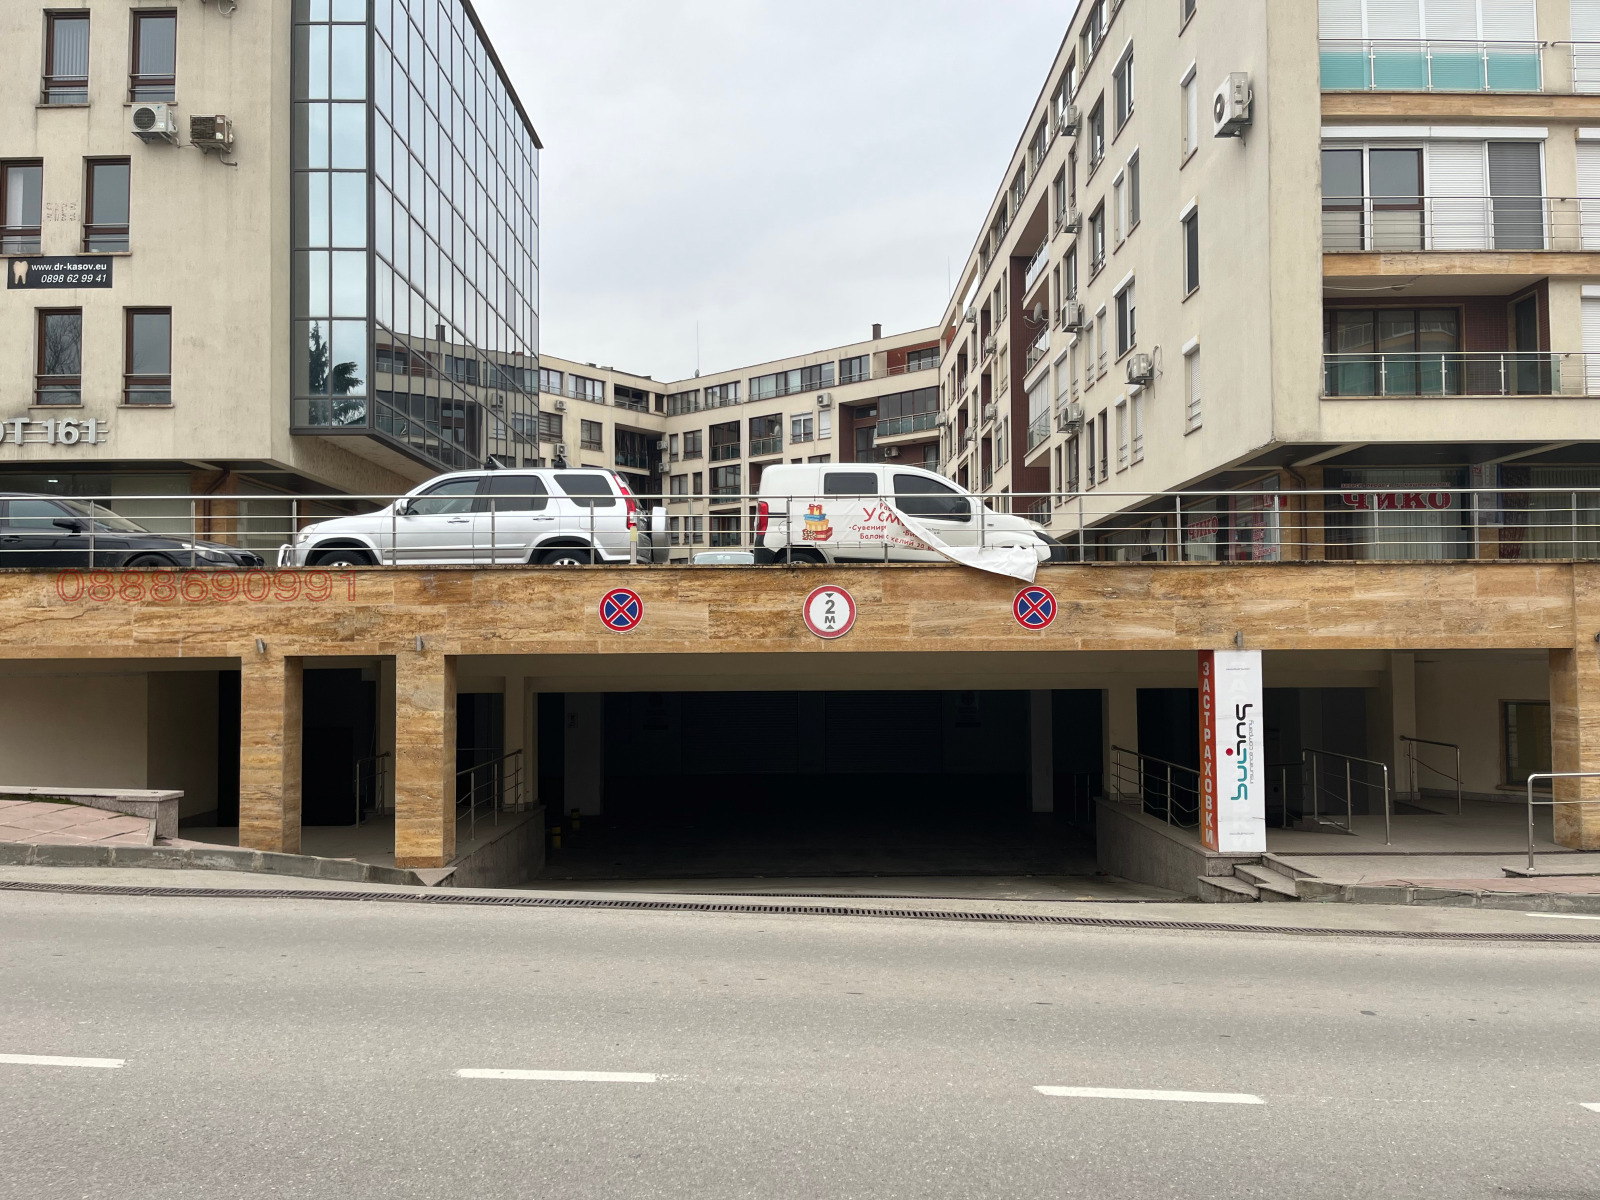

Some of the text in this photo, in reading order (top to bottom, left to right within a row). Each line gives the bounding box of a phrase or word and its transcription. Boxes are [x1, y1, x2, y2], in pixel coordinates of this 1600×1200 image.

[31, 262, 107, 271] www.dr-kasov.eu
[41, 273, 107, 283] 0898 62 99 41
[41, 417, 98, 445] 161
[1341, 490, 1452, 510] ЧИКО
[1188, 515, 1219, 539] ЧИКО
[56, 569, 356, 602] 0888690991
[825, 599, 836, 615] 2
[1202, 661, 1214, 845] ЗАСТРАХОВКИ
